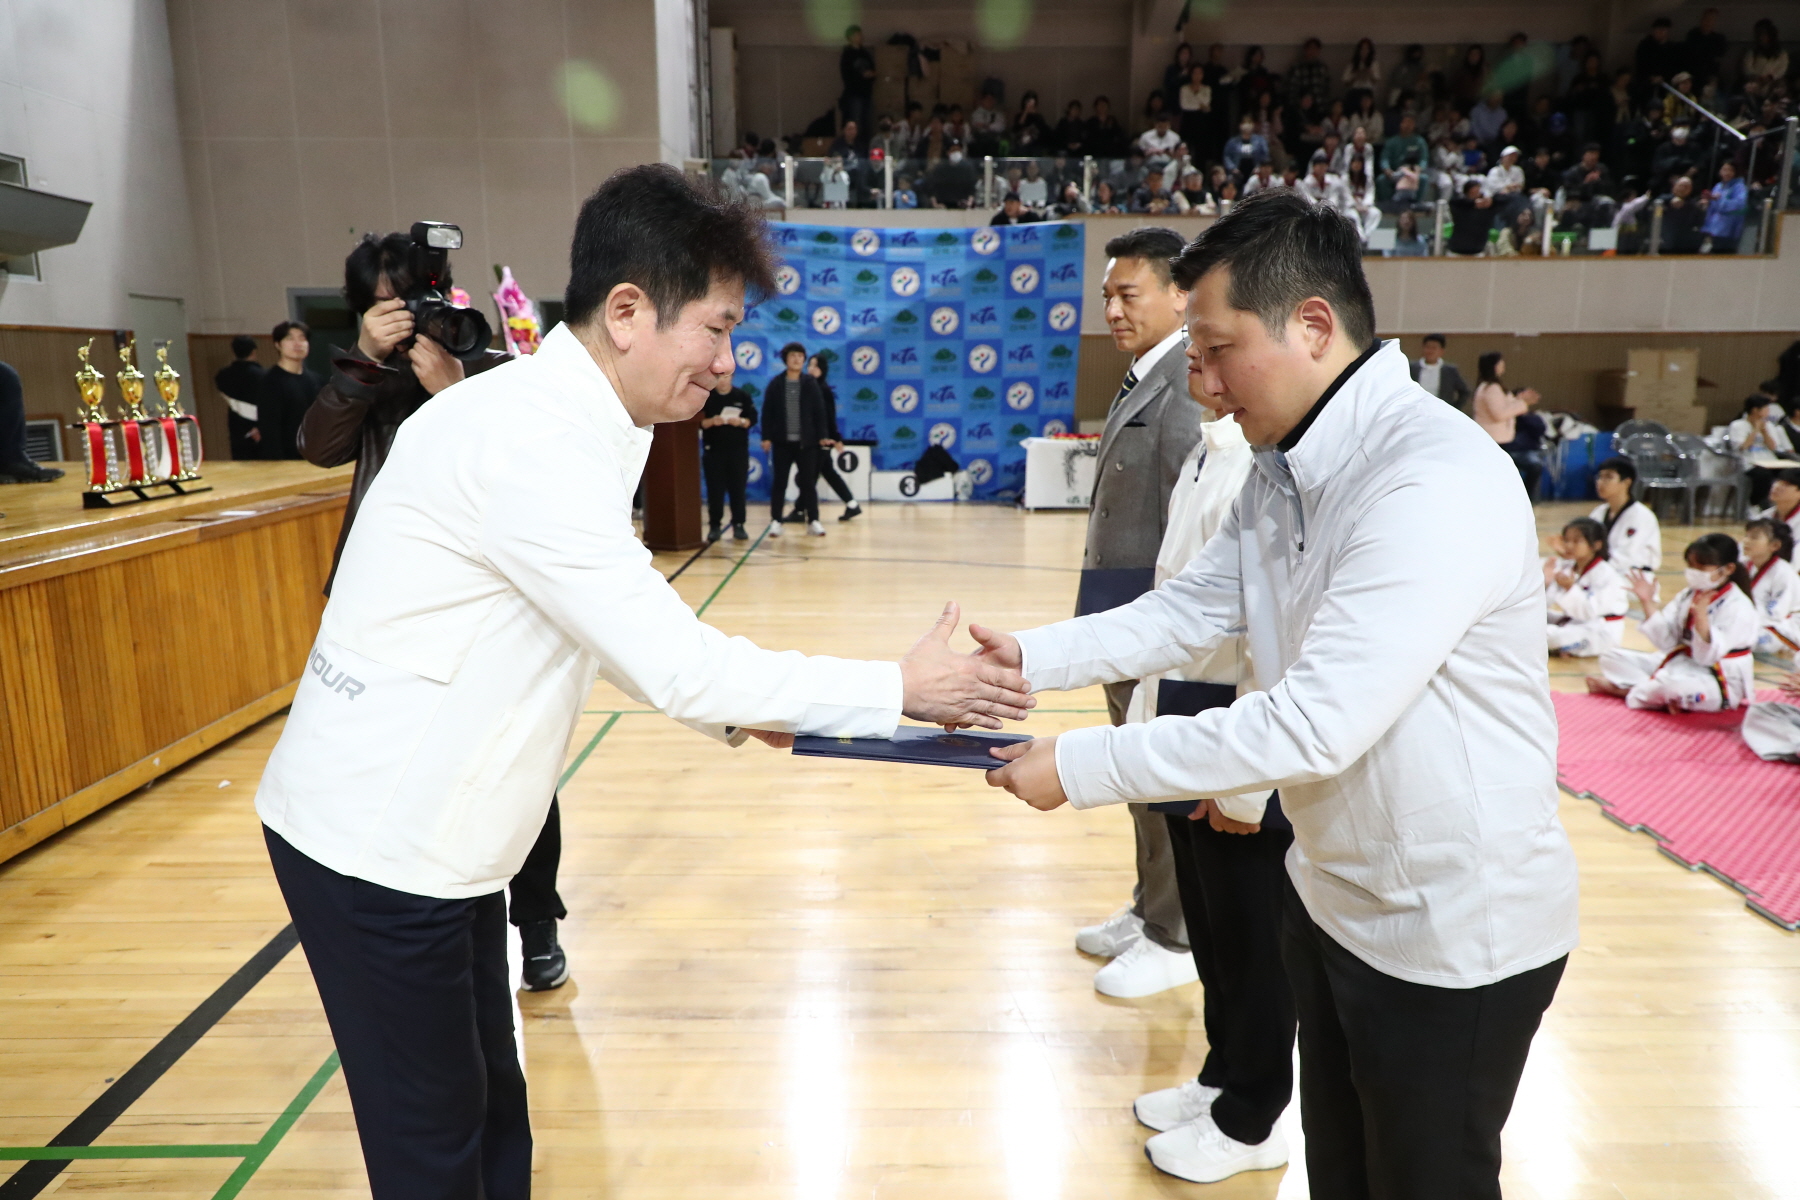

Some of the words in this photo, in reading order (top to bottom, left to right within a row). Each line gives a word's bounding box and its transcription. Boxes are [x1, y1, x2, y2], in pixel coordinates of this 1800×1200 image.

[891, 231, 919, 247] KTA
[1011, 226, 1039, 244] KTA
[811, 267, 838, 286] KTA
[931, 268, 959, 287] KTA
[1050, 263, 1077, 281] KTA
[851, 308, 878, 326] KTA
[970, 306, 997, 324] KTA
[890, 346, 918, 365] KTA
[1008, 344, 1035, 362] KTA
[929, 384, 956, 403] KTA
[1045, 381, 1070, 400] KTA
[967, 422, 994, 440] KTA
[903, 477, 915, 495] 3
